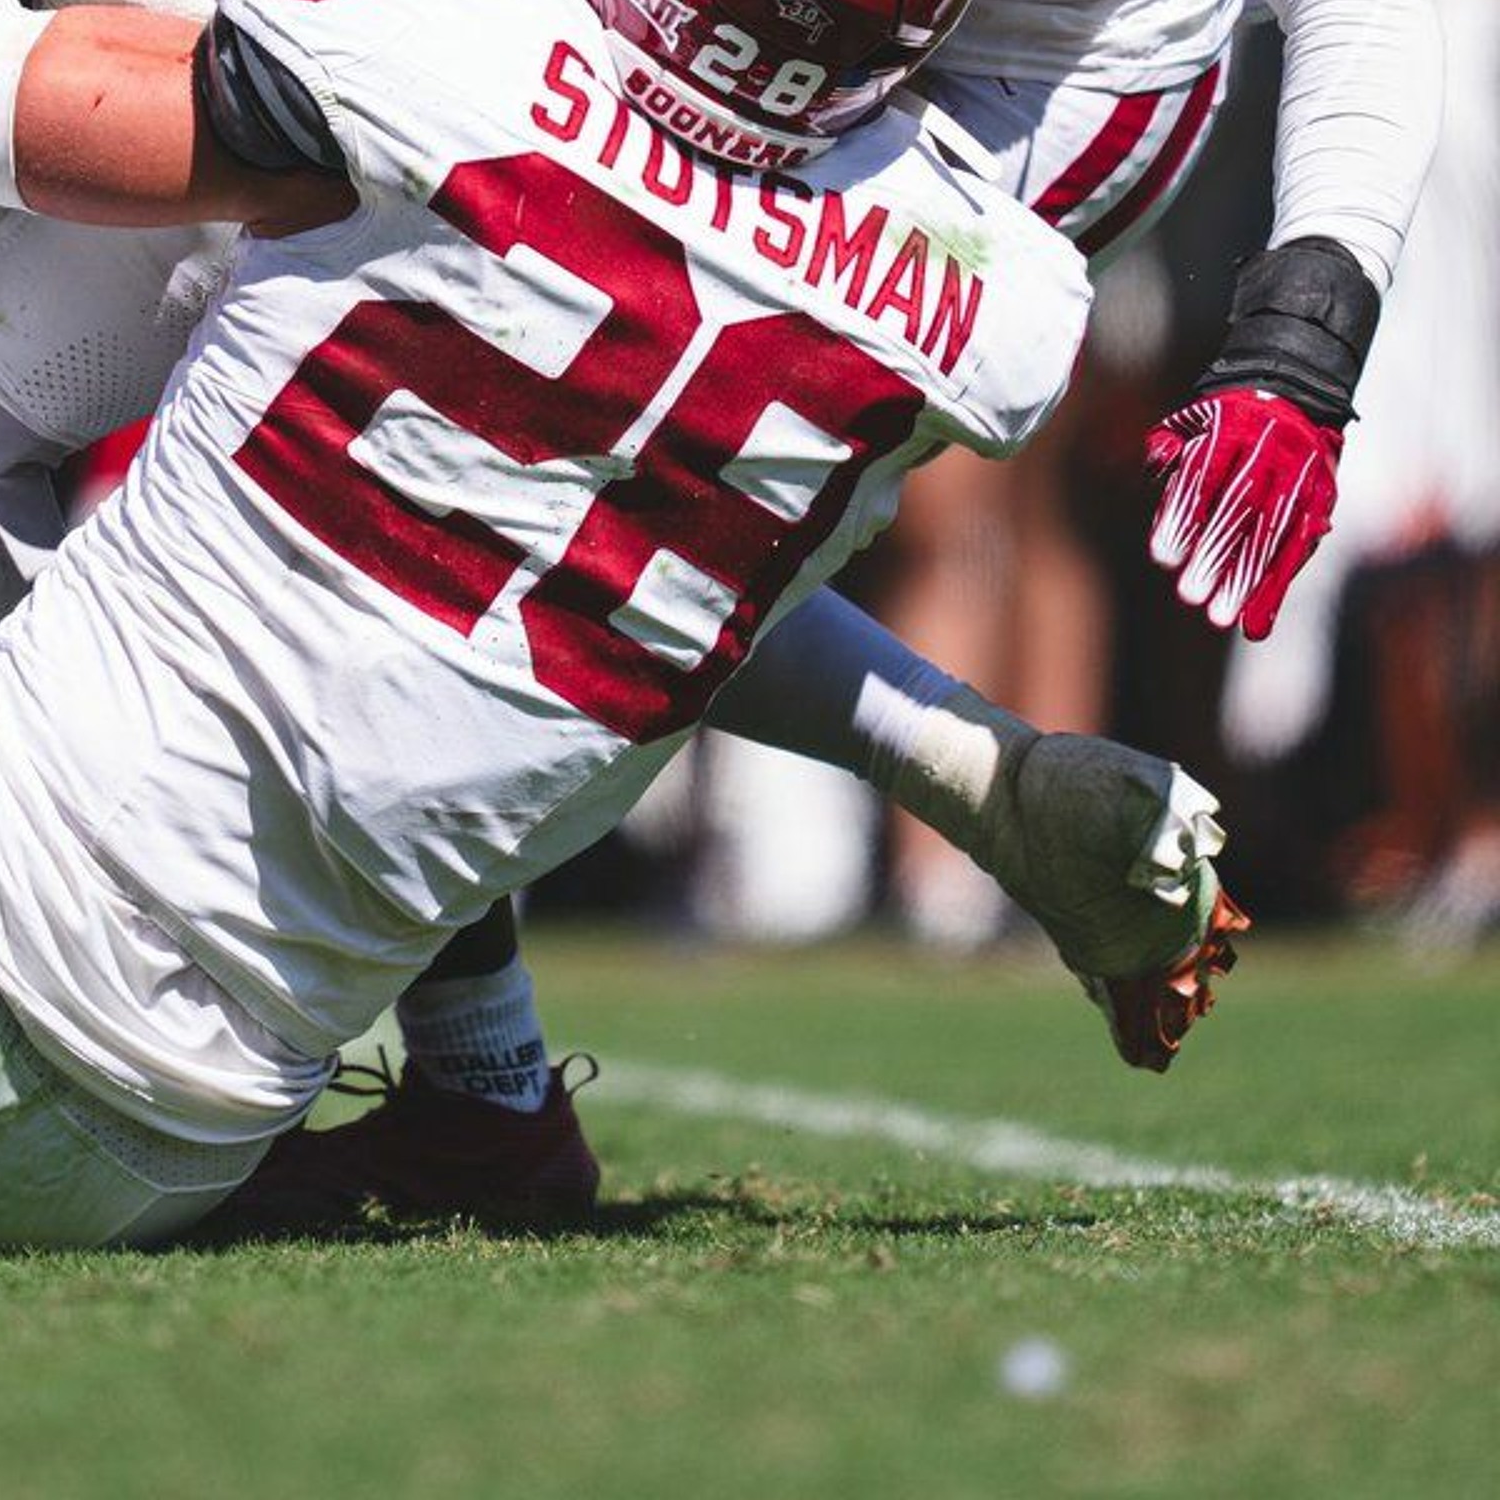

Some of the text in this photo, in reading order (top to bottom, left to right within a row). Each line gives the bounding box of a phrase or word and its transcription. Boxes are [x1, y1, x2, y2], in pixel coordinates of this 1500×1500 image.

[530, 39, 984, 378] STUTSMAN
[625, 67, 809, 168] SOONERS
[230, 150, 926, 745] 28
